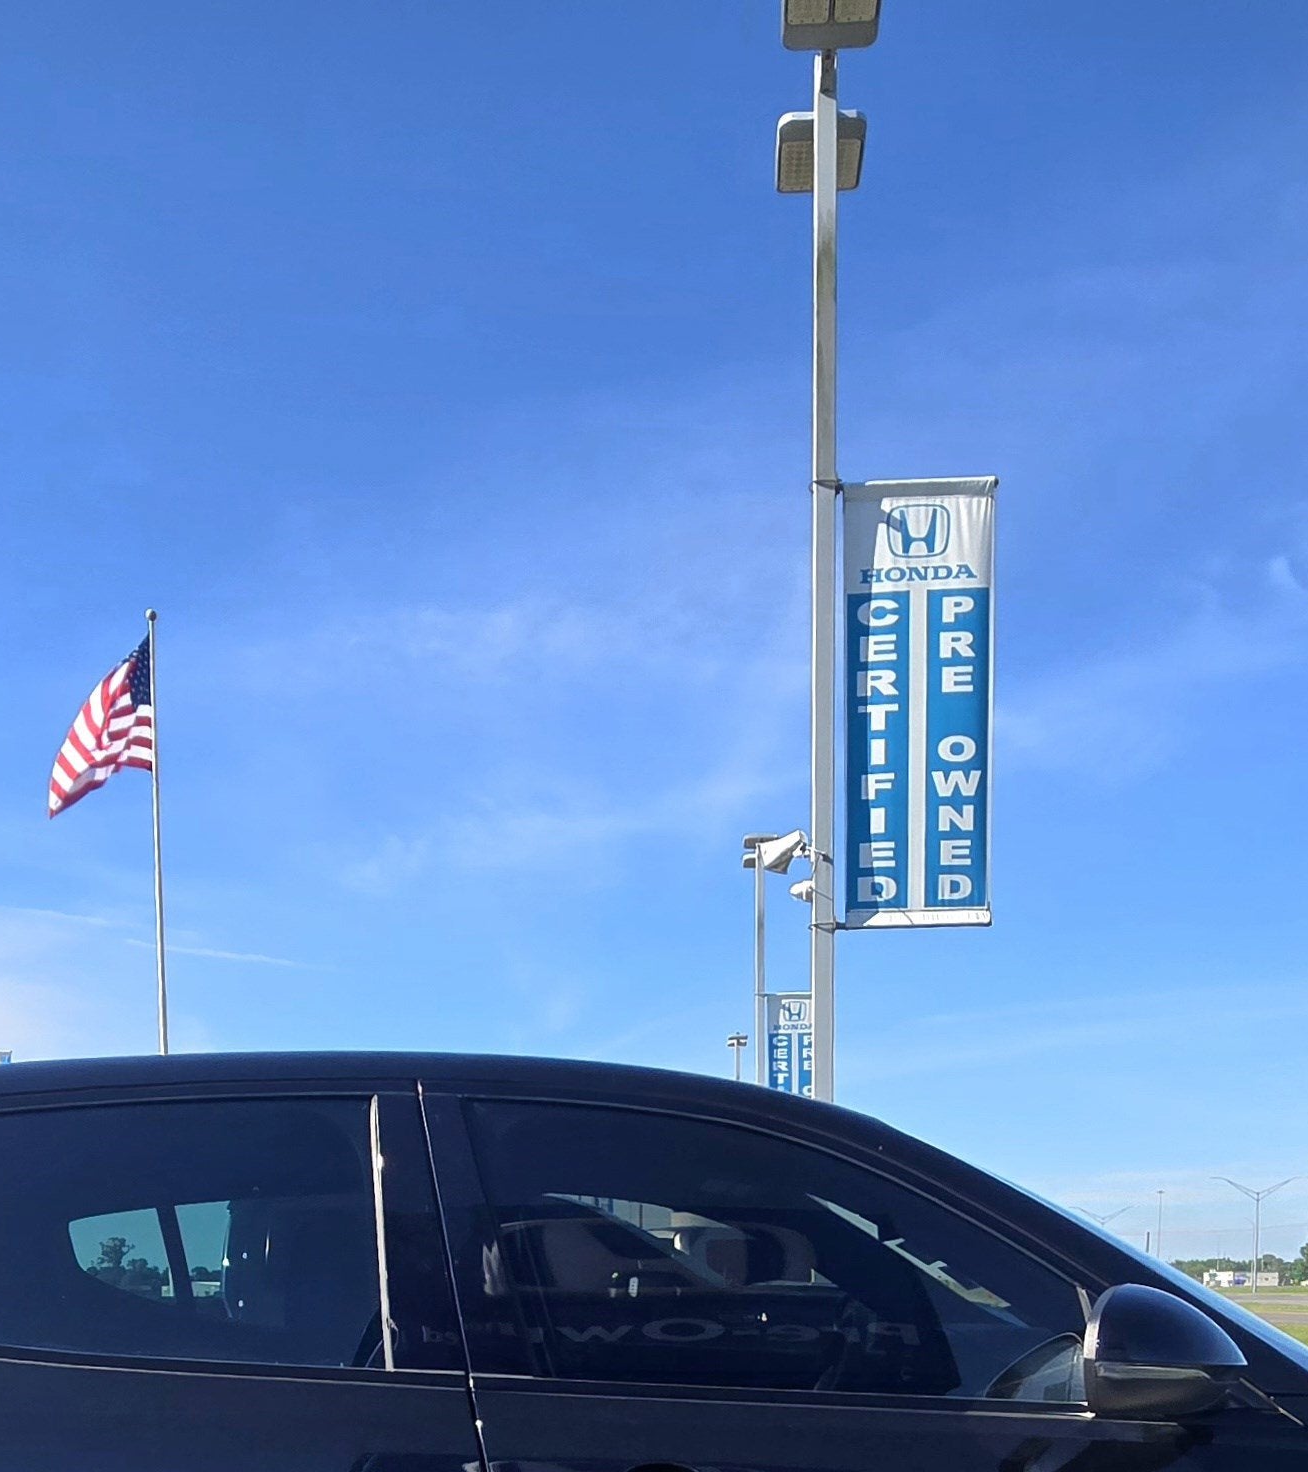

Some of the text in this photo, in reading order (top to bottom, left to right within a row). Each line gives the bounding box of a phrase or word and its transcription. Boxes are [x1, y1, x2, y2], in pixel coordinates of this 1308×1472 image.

[859, 563, 977, 584] HONDA
[856, 598, 900, 902] CERTIFIED
[931, 596, 981, 901] PRE OWNED
